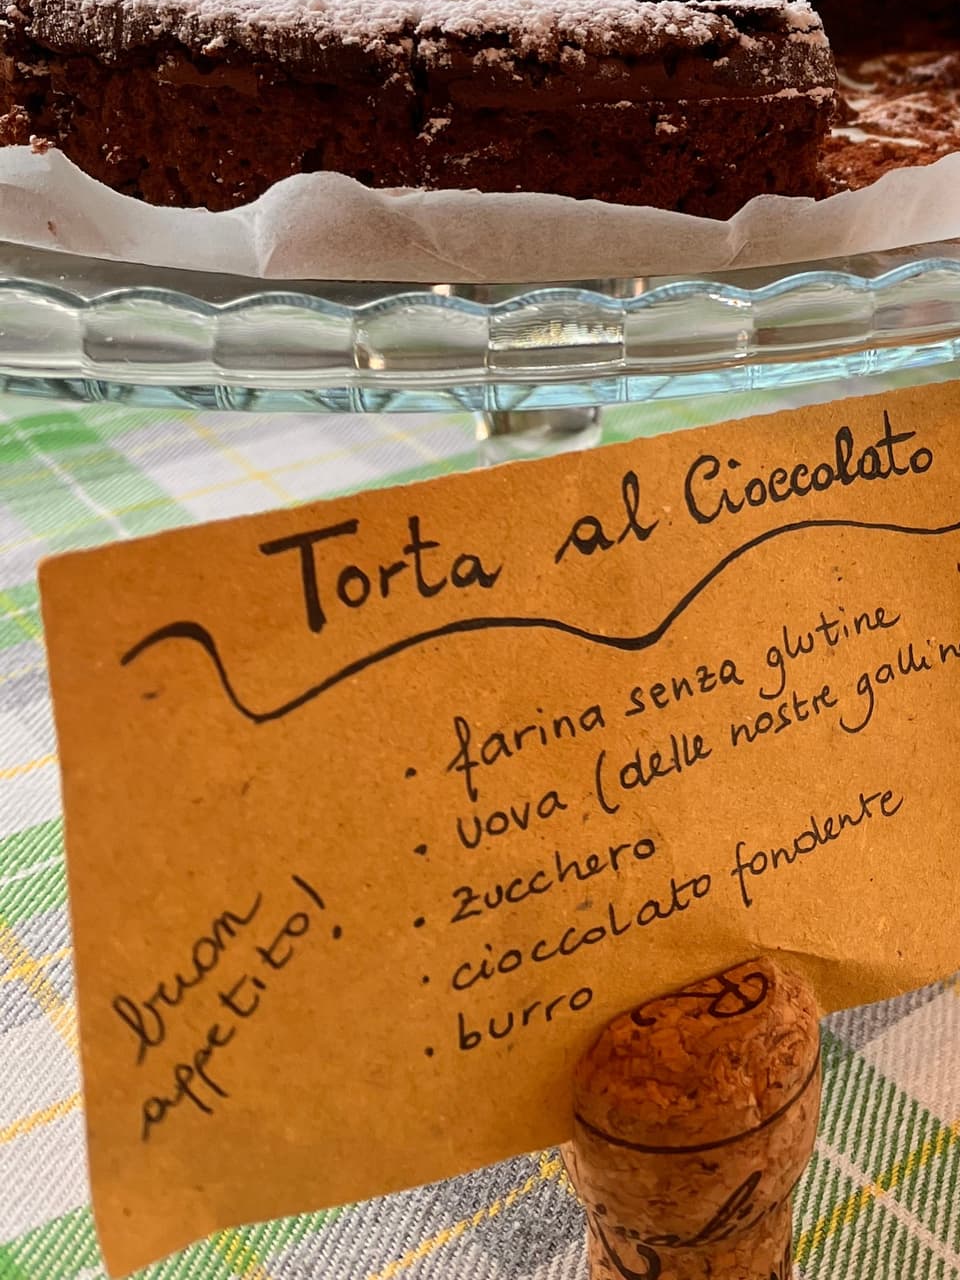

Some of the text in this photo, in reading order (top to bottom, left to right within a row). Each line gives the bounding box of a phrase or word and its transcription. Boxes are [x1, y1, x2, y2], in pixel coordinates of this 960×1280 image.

[260, 409, 934, 634] Torta al Cioccolato
[446, 605, 902, 802] farina senza glutine
[455, 789, 568, 850] uova
[594, 731, 713, 815] (delle
[730, 683, 839, 747] nostre
[449, 836, 657, 924] zucchero
[451, 786, 905, 992] cioccolato fondente
[112, 891, 263, 1067] buon
[140, 874, 344, 1143] appetito!
[456, 986, 594, 1052] burro
